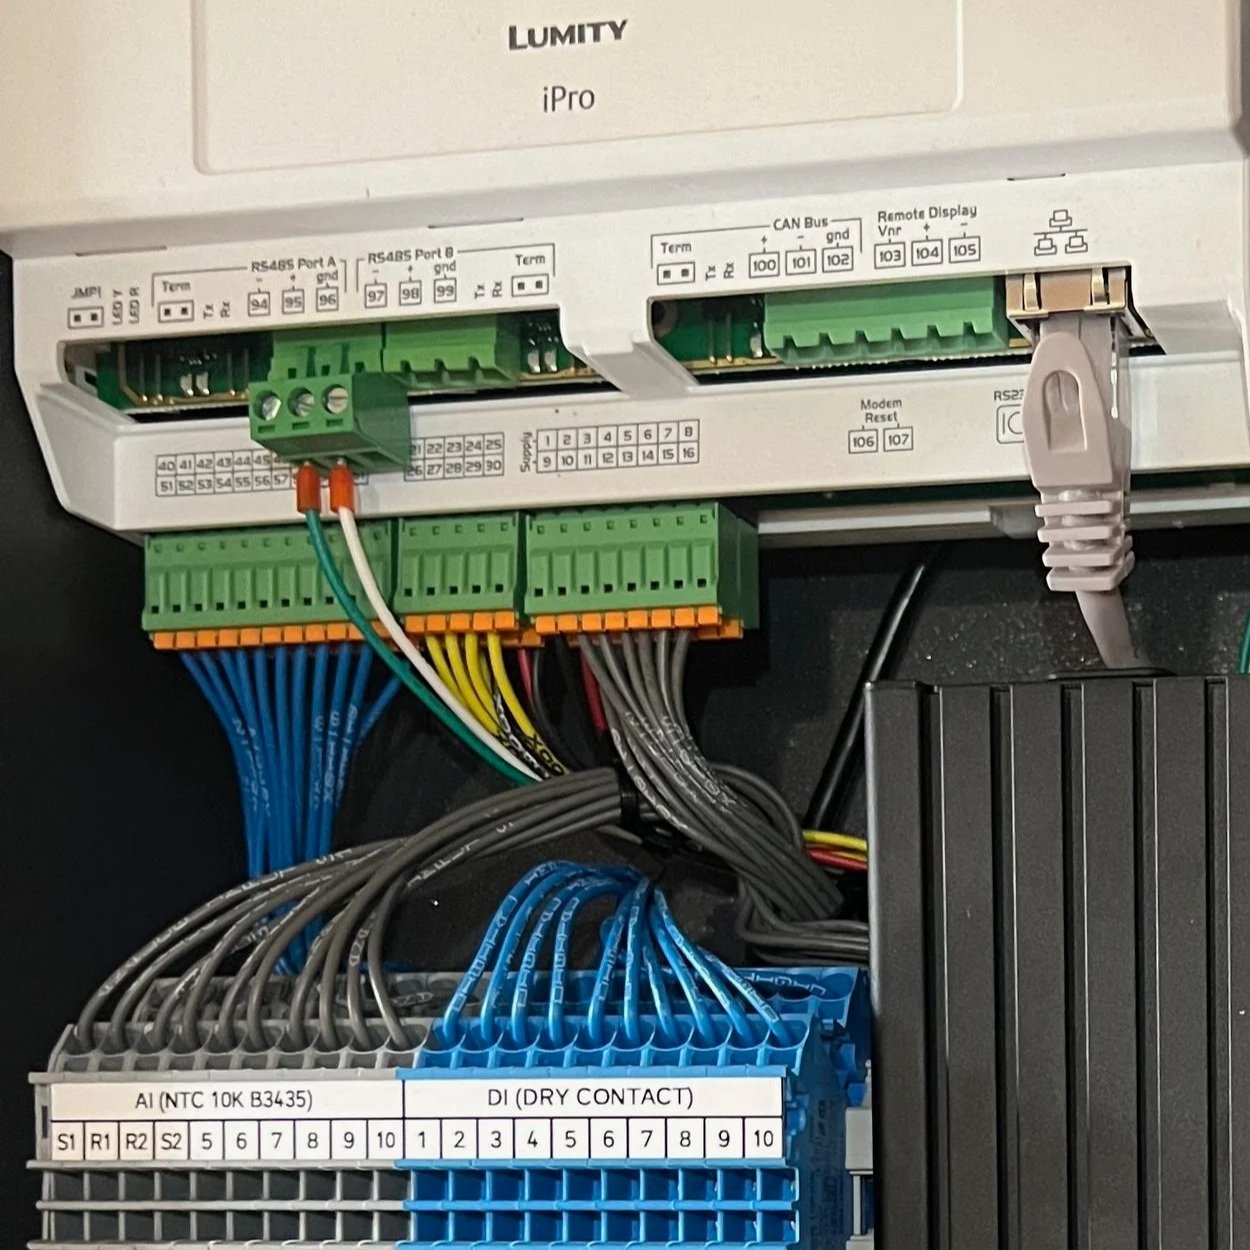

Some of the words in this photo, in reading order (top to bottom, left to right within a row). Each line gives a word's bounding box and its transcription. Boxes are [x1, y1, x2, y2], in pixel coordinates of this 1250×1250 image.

[507, 20, 628, 50] LUMITY
[543, 86, 595, 113] iPro
[877, 208, 926, 223] Remote
[928, 205, 978, 221] Display
[773, 217, 801, 232] CAN
[804, 215, 829, 229] Bus
[826, 230, 851, 244] gnd
[367, 250, 412, 264] RS485
[415, 249, 441, 260] Port
[660, 240, 692, 255] Term
[879, 249, 902, 263] 103
[915, 247, 940, 261] 104
[953, 243, 976, 257] 105
[251, 259, 295, 272] RS485
[297, 259, 323, 269] Port
[326, 256, 337, 268] A
[434, 260, 457, 275] gnd
[515, 254, 546, 267] Term
[752, 260, 776, 273] 100
[791, 256, 812, 269] 101
[826, 253, 850, 267] 102
[368, 290, 385, 302] 97
[402, 289, 420, 300] 98
[436, 285, 455, 297] 99
[860, 399, 902, 410] Modem
[865, 411, 898, 424] Reset
[853, 437, 875, 448] 106
[888, 433, 910, 445] 107
[521, 432, 532, 473] Supply
[135, 1091, 154, 1109] AI
[159, 1090, 204, 1113] (NTC
[211, 1090, 243, 1109] 10K
[250, 1089, 313, 1112] B3435)
[488, 1088, 508, 1106] DI
[515, 1087, 568, 1110] (DRY
[576, 1086, 694, 1109] CONTACT)
[57, 1131, 76, 1151] S1
[91, 1131, 111, 1151] R1
[126, 1131, 147, 1151] R2
[161, 1131, 182, 1151] S2
[201, 1131, 212, 1151] 5
[236, 1131, 247, 1151] 6
[271, 1131, 282, 1151] 7
[307, 1131, 319, 1151] 8
[343, 1131, 355, 1151] 9
[377, 1131, 395, 1151] 10
[418, 1130, 426, 1148] 1
[454, 1130, 465, 1148] 2
[490, 1130, 502, 1148] 3
[526, 1130, 538, 1148] 4
[565, 1130, 576, 1148] 5
[603, 1130, 614, 1148] 6
[641, 1130, 653, 1148] 7
[679, 1130, 691, 1148] 8
[718, 1130, 730, 1148] 9
[754, 1130, 774, 1148] 10
